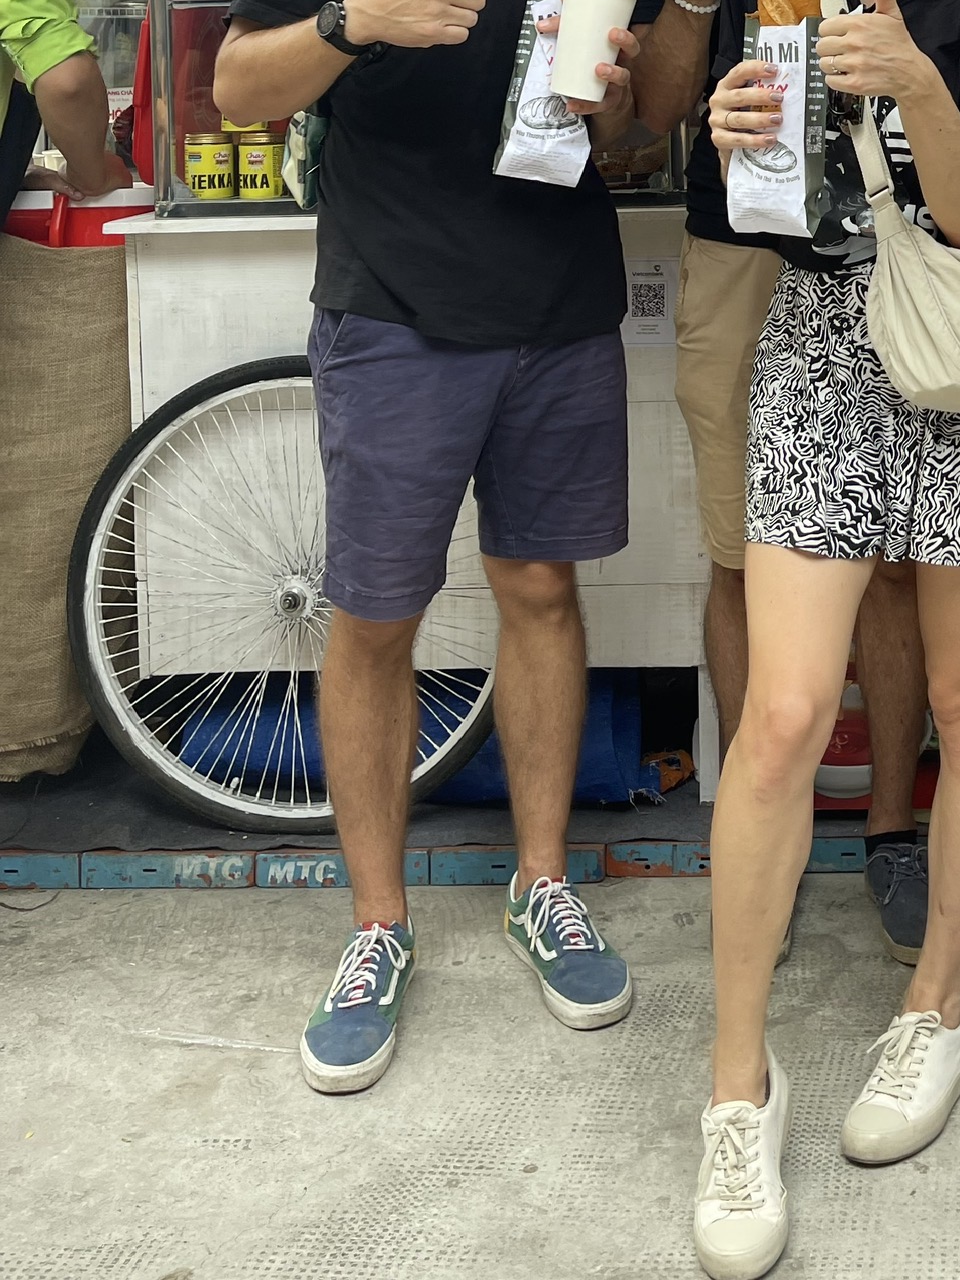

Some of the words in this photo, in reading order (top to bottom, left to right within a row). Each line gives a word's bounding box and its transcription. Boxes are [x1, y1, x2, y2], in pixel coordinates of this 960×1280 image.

[778, 41, 799, 63] Mì
[174, 857, 243, 881] MTC
[267, 860, 337, 884] MTC
